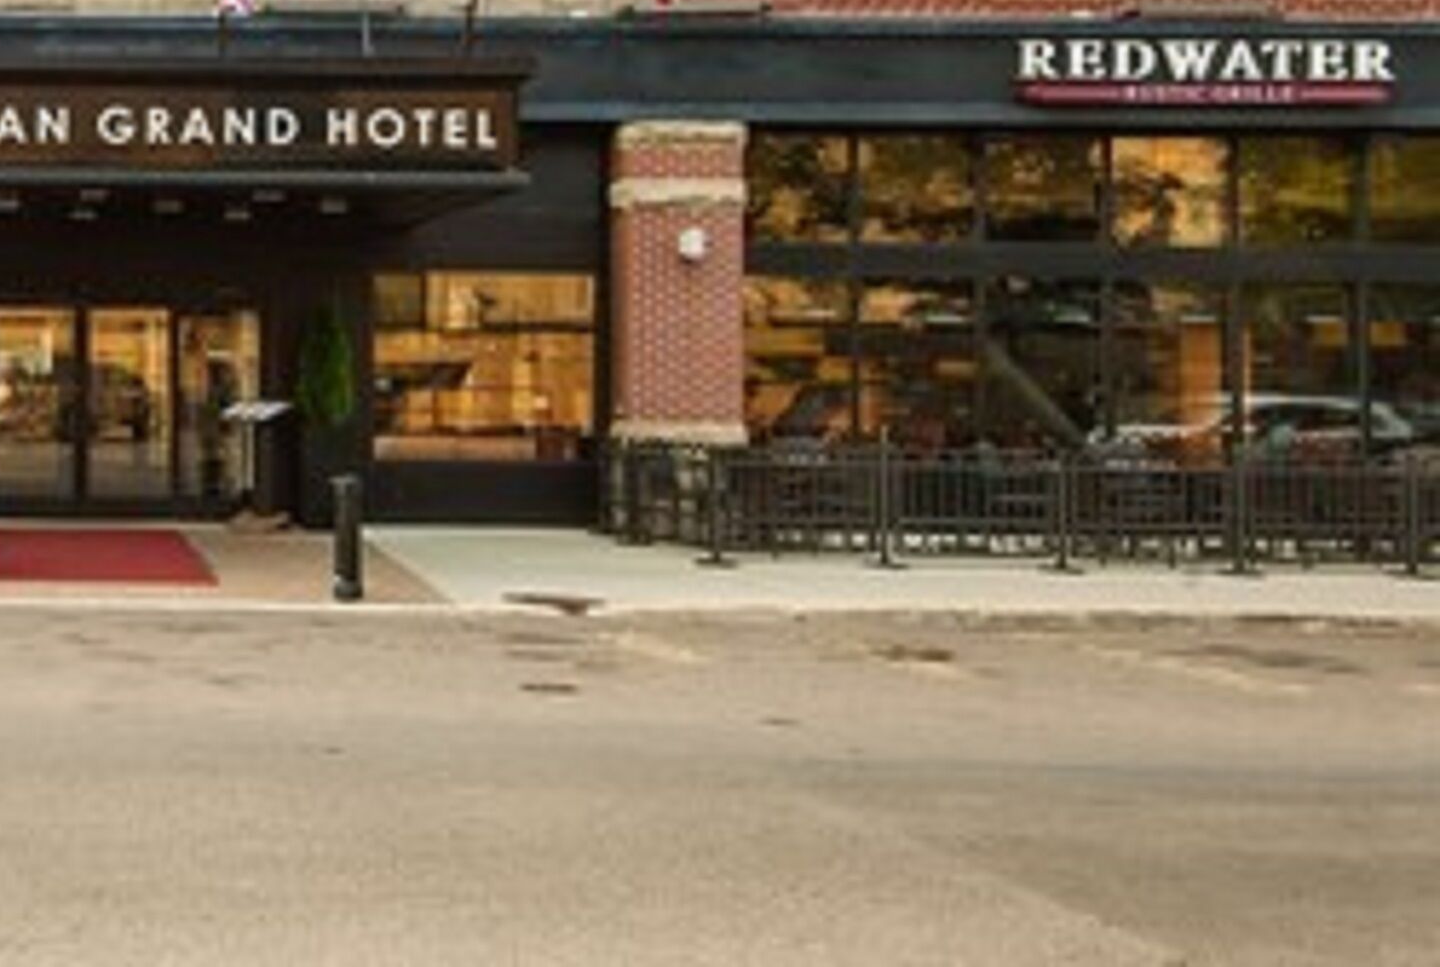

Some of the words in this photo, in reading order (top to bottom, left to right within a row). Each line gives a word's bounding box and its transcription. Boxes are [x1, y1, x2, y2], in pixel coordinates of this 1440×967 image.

[1019, 39, 1395, 81] REDWATER
[97, 105, 301, 146] GRAND
[327, 107, 498, 149] HOTEL
